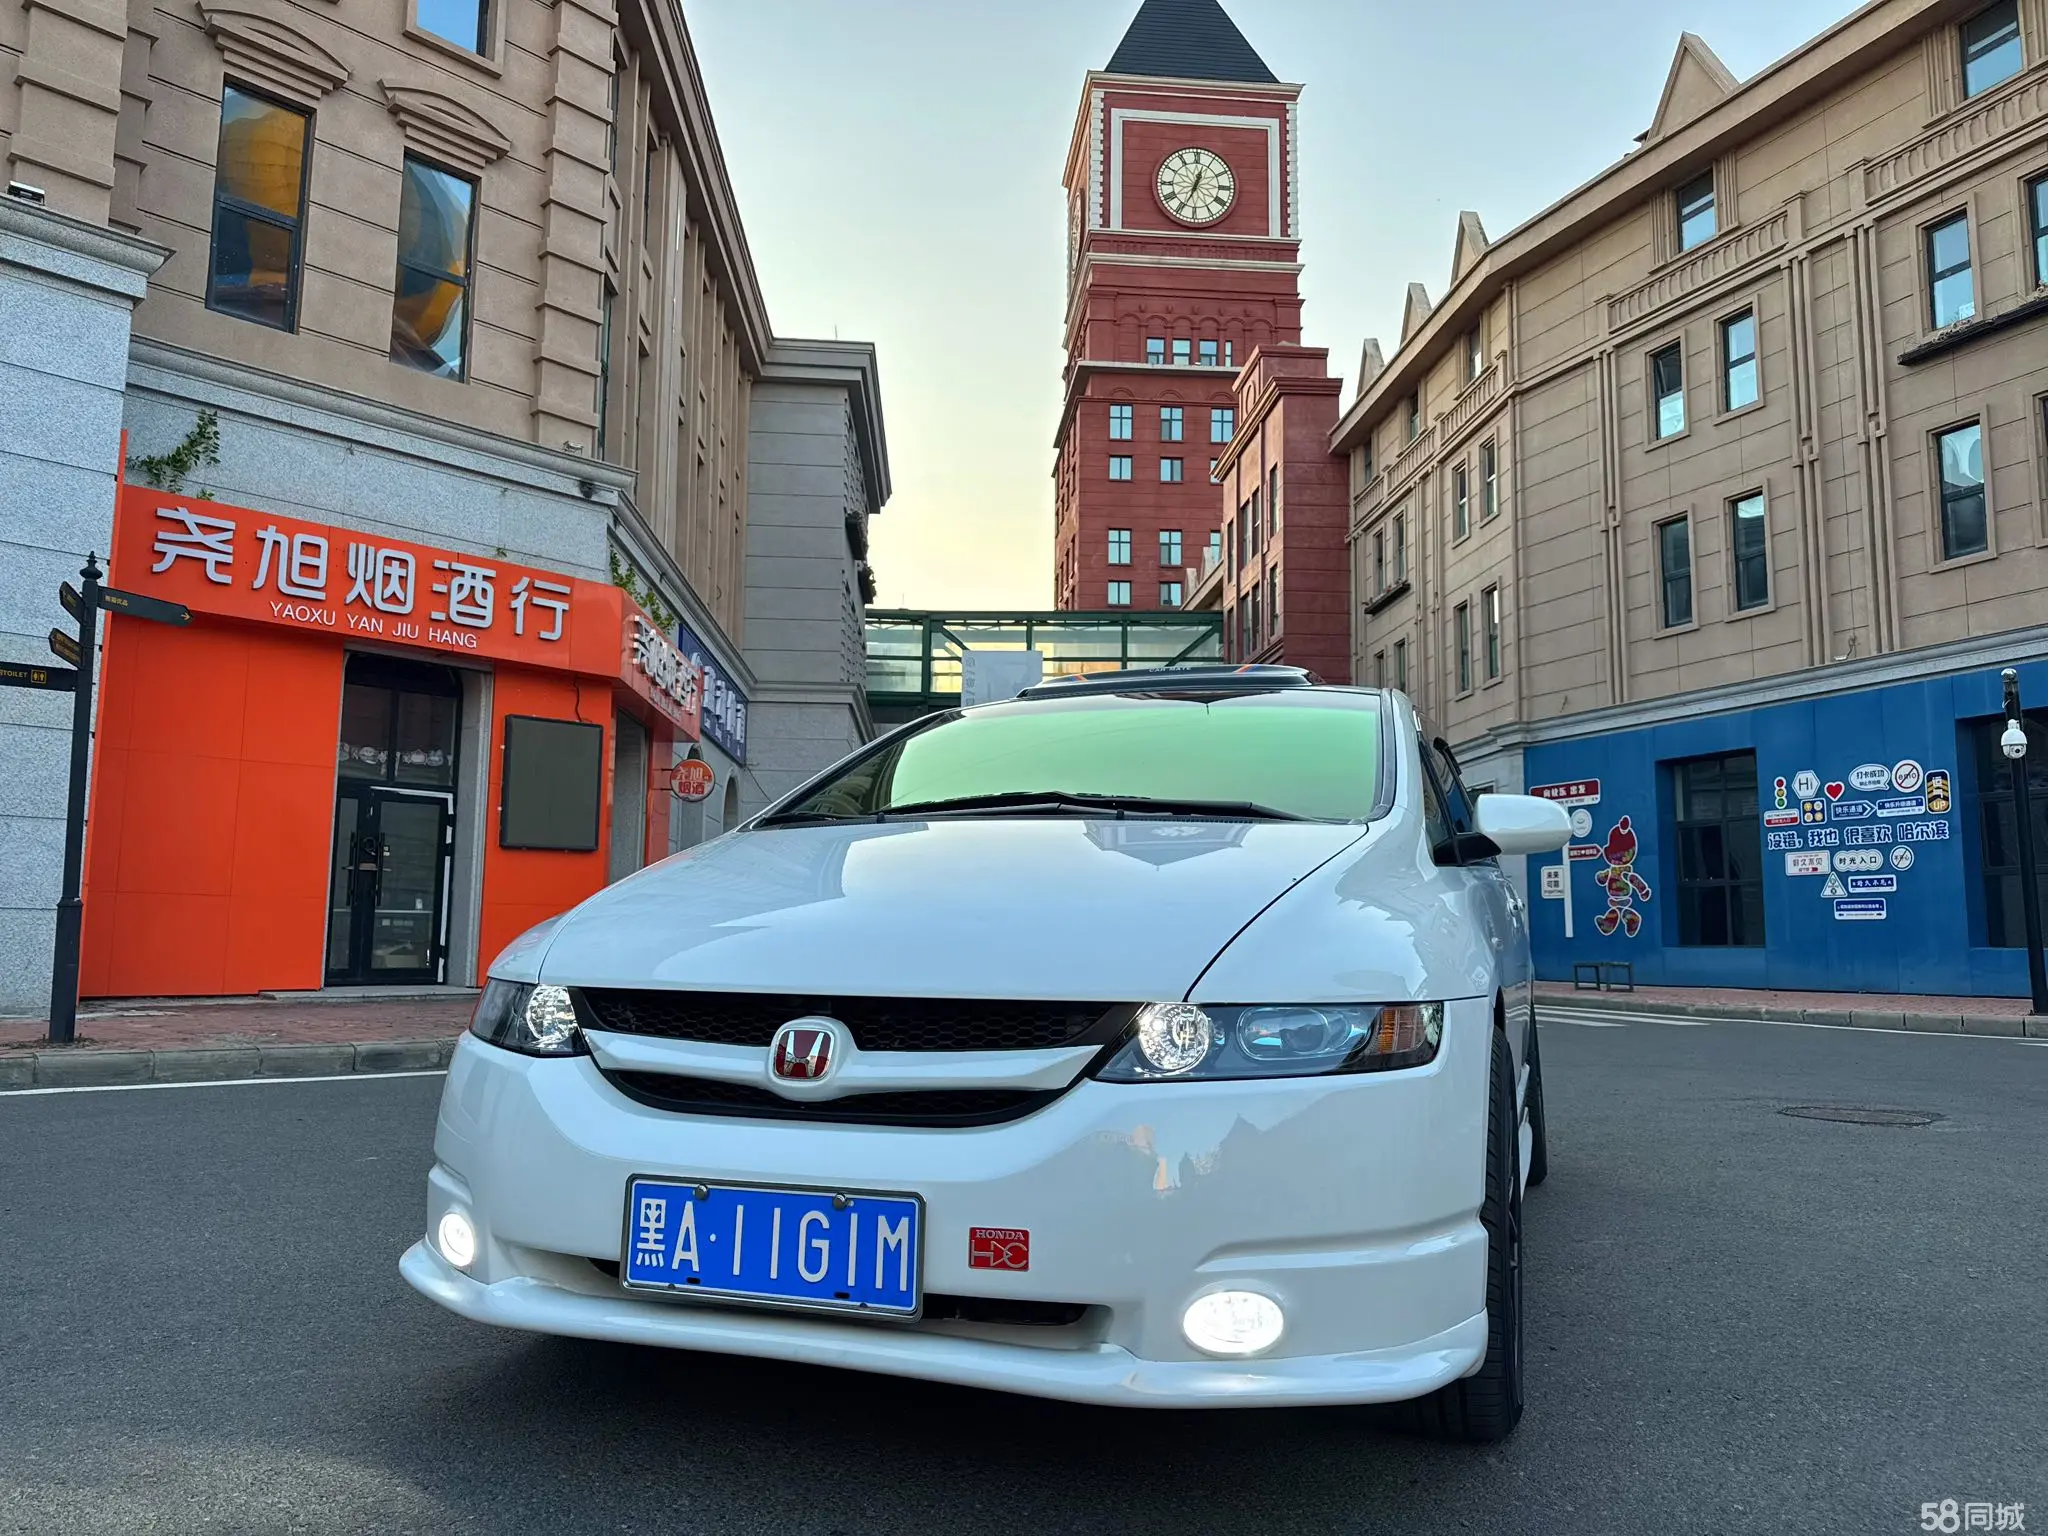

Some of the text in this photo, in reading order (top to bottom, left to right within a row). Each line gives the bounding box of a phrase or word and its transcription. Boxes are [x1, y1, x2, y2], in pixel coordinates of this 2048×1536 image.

[152, 506, 571, 641] 尧旭烟酒行
[269, 601, 478, 649] YAOXU YAN JIU HANG
[1835, 805, 1863, 814] 快乐通道
[1933, 801, 1947, 809] UP
[1808, 828, 1839, 847] 我也
[1844, 824, 1892, 845] 很喜欢
[1897, 820, 1949, 842] 哈尔滨
[1838, 856, 1877, 866] 时光入口
[975, 1229, 1026, 1241] HONDA
